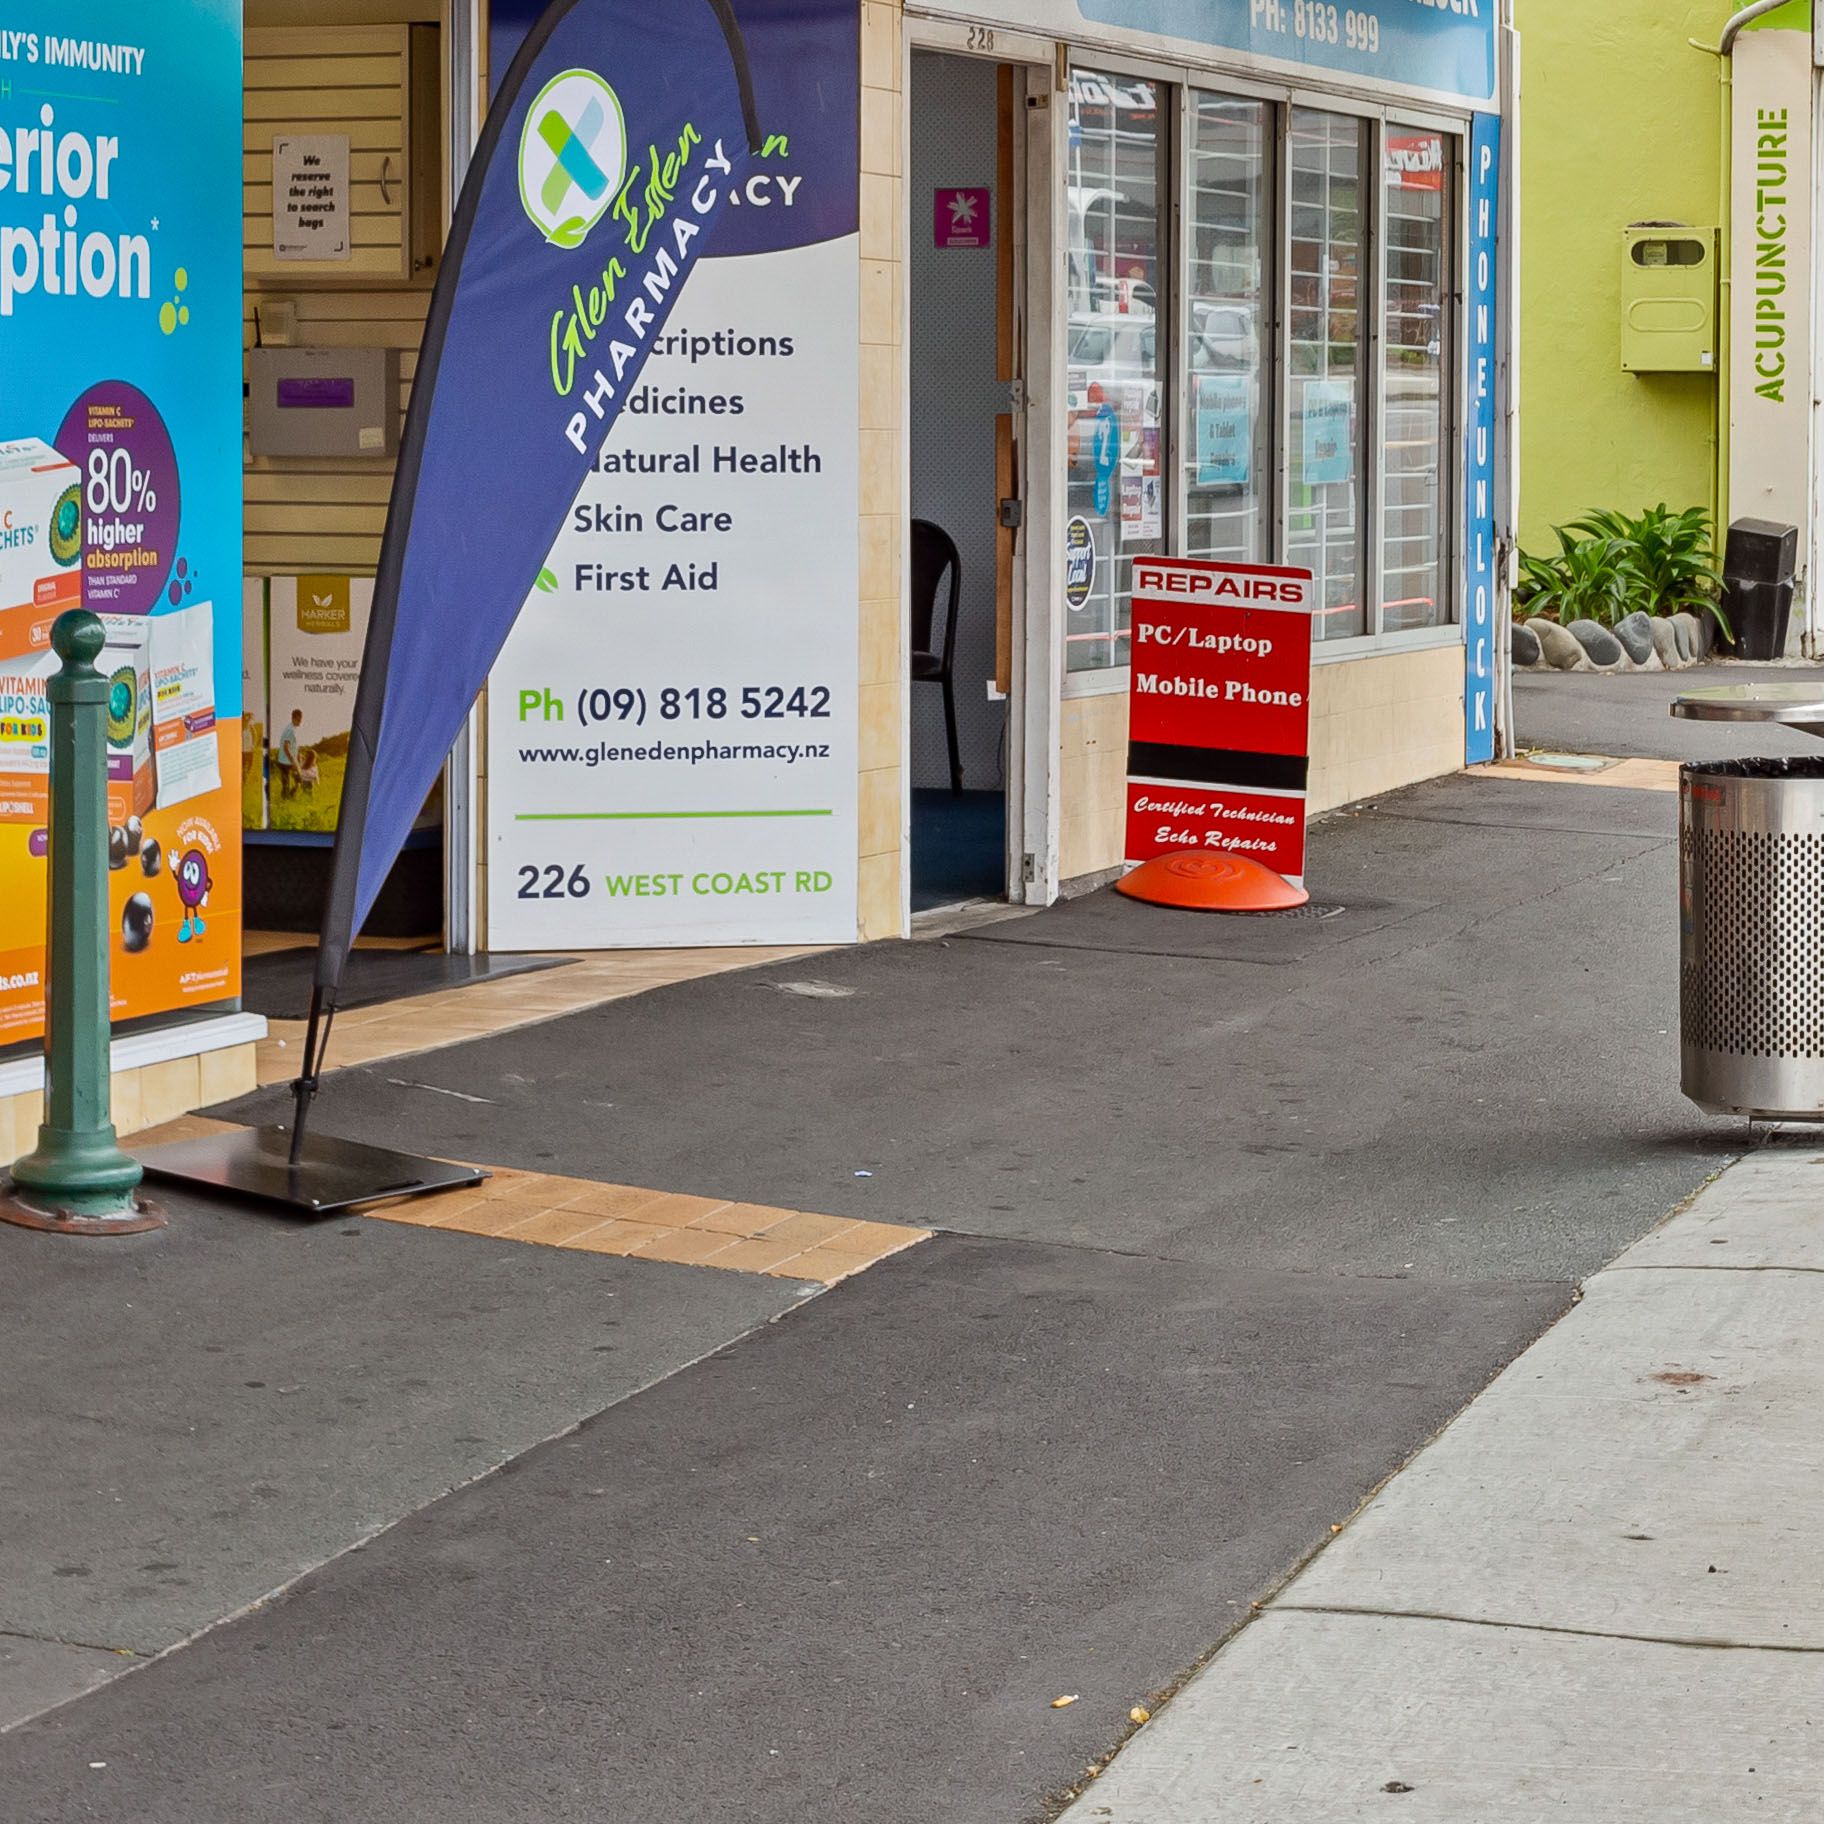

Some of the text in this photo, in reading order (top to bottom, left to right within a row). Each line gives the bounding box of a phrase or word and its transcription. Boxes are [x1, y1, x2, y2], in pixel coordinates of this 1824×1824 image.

[966, 25, 995, 52] 228
[1345, 8, 1380, 53] 999
[44, 37, 145, 76] IMMUNITY
[302, 154, 321, 167] We
[287, 201, 335, 213] to search
[288, 186, 334, 200] the right
[298, 216, 324, 231] bags
[549, 121, 703, 396] Glen Eden
[1477, 142, 1493, 398] PHONE
[1754, 106, 1789, 405] ACUPUNCTURE
[564, 139, 733, 456] PHARMACY
[87, 406, 116, 417] VITAMIN
[712, 444, 822, 475] Health
[86, 447, 157, 514] 80%
[4, 510, 14, 530] C
[87, 517, 145, 551] higher
[573, 504, 734, 534] Skin Care
[87, 547, 158, 572] absorption
[574, 562, 719, 592] First Aid
[1138, 570, 1304, 604] REPAIRS
[1474, 440, 1490, 732] UNLOCK
[301, 608, 346, 621] HARKER
[1136, 622, 1273, 658] PC/Laptop
[282, 668, 324, 680] wellness
[291, 655, 359, 671] We have your
[1136, 672, 1302, 708] Mobile Phone
[518, 685, 831, 727] Ph (09) 818 5242
[0, 720, 43, 737] FOR KIDS
[518, 738, 830, 767] www.glenedenpharmacy.nz
[1133, 794, 1296, 825] Certified Technician
[1154, 824, 1278, 853] Echo Repairs
[517, 863, 834, 900] 226 WEST COAST RD
